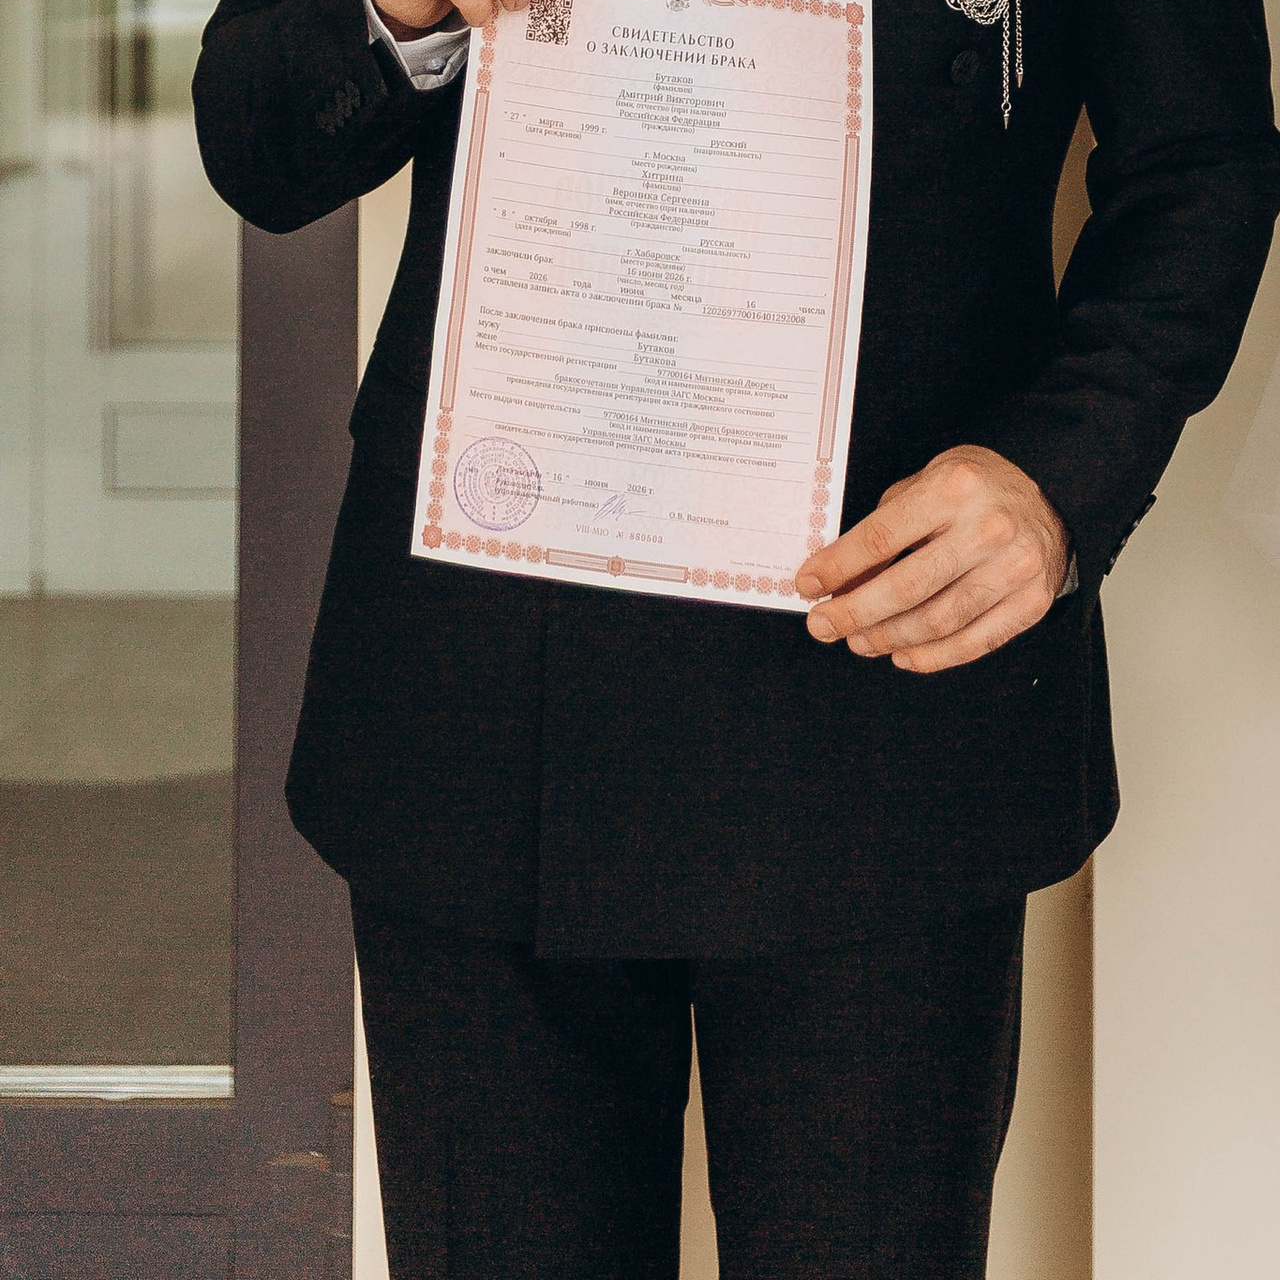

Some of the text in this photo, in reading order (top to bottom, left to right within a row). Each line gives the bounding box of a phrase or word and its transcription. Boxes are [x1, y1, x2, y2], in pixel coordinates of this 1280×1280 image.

[611, 25, 734, 48] СВИДЕТЕЛЬСТВО
[586, 40, 757, 69] О ЗАКЛЮЧЕНИИ БРАКА
[655, 72, 693, 83] Бутаков
[618, 89, 724, 107] Дмитрий Викторович
[509, 111, 519, 120] 27
[539, 118, 564, 128] марта
[580, 123, 599, 132] 1999
[619, 109, 720, 127] Российская Федерация
[709, 139, 746, 148] русский
[652, 151, 685, 162] Москва
[641, 170, 683, 181] Хитрина
[612, 187, 709, 206] Вероника Сергеевна
[524, 214, 557, 226] октября
[569, 220, 589, 229] 1998
[608, 206, 708, 225] Российская Федерация
[699, 238, 734, 247] русская
[485, 247, 532, 260] заключили
[533, 253, 553, 263] брак
[626, 266, 636, 274] 16
[638, 269, 662, 278] июня
[665, 271, 684, 280] 2026
[634, 248, 681, 260] Хабаровск
[482, 276, 528, 289] составлена
[529, 284, 558, 293] запись
[560, 289, 579, 297] акта
[588, 293, 643, 305] заключении
[645, 299, 670, 309] брака
[673, 302, 682, 310] №
[483, 265, 506, 274] чем
[529, 271, 548, 281] 2026
[572, 280, 591, 288] года
[620, 286, 644, 295] июня
[670, 293, 702, 302] месяца
[746, 300, 756, 308] 16
[798, 306, 825, 314] числа
[479, 306, 679, 342] После заключения брака присвоены фамилии:
[478, 319, 674, 353] мужу Бутаков
[476, 331, 676, 366] жене Бутакова
[474, 341, 775, 390] Место государственной регистрации 97700164 Митинский Дворец
[554, 373, 725, 402] бракосочетания Управления ЗАГС Москвы
[469, 389, 788, 439] Место выдачи свидетельства 97700164 Митинский Дворец бракосочетания
[582, 426, 686, 447] Управления ЗАГС Москвы
[552, 472, 562, 480] 16
[584, 479, 609, 488] июня
[626, 483, 646, 493] 2026
[668, 510, 729, 525] О.В. Васильева
